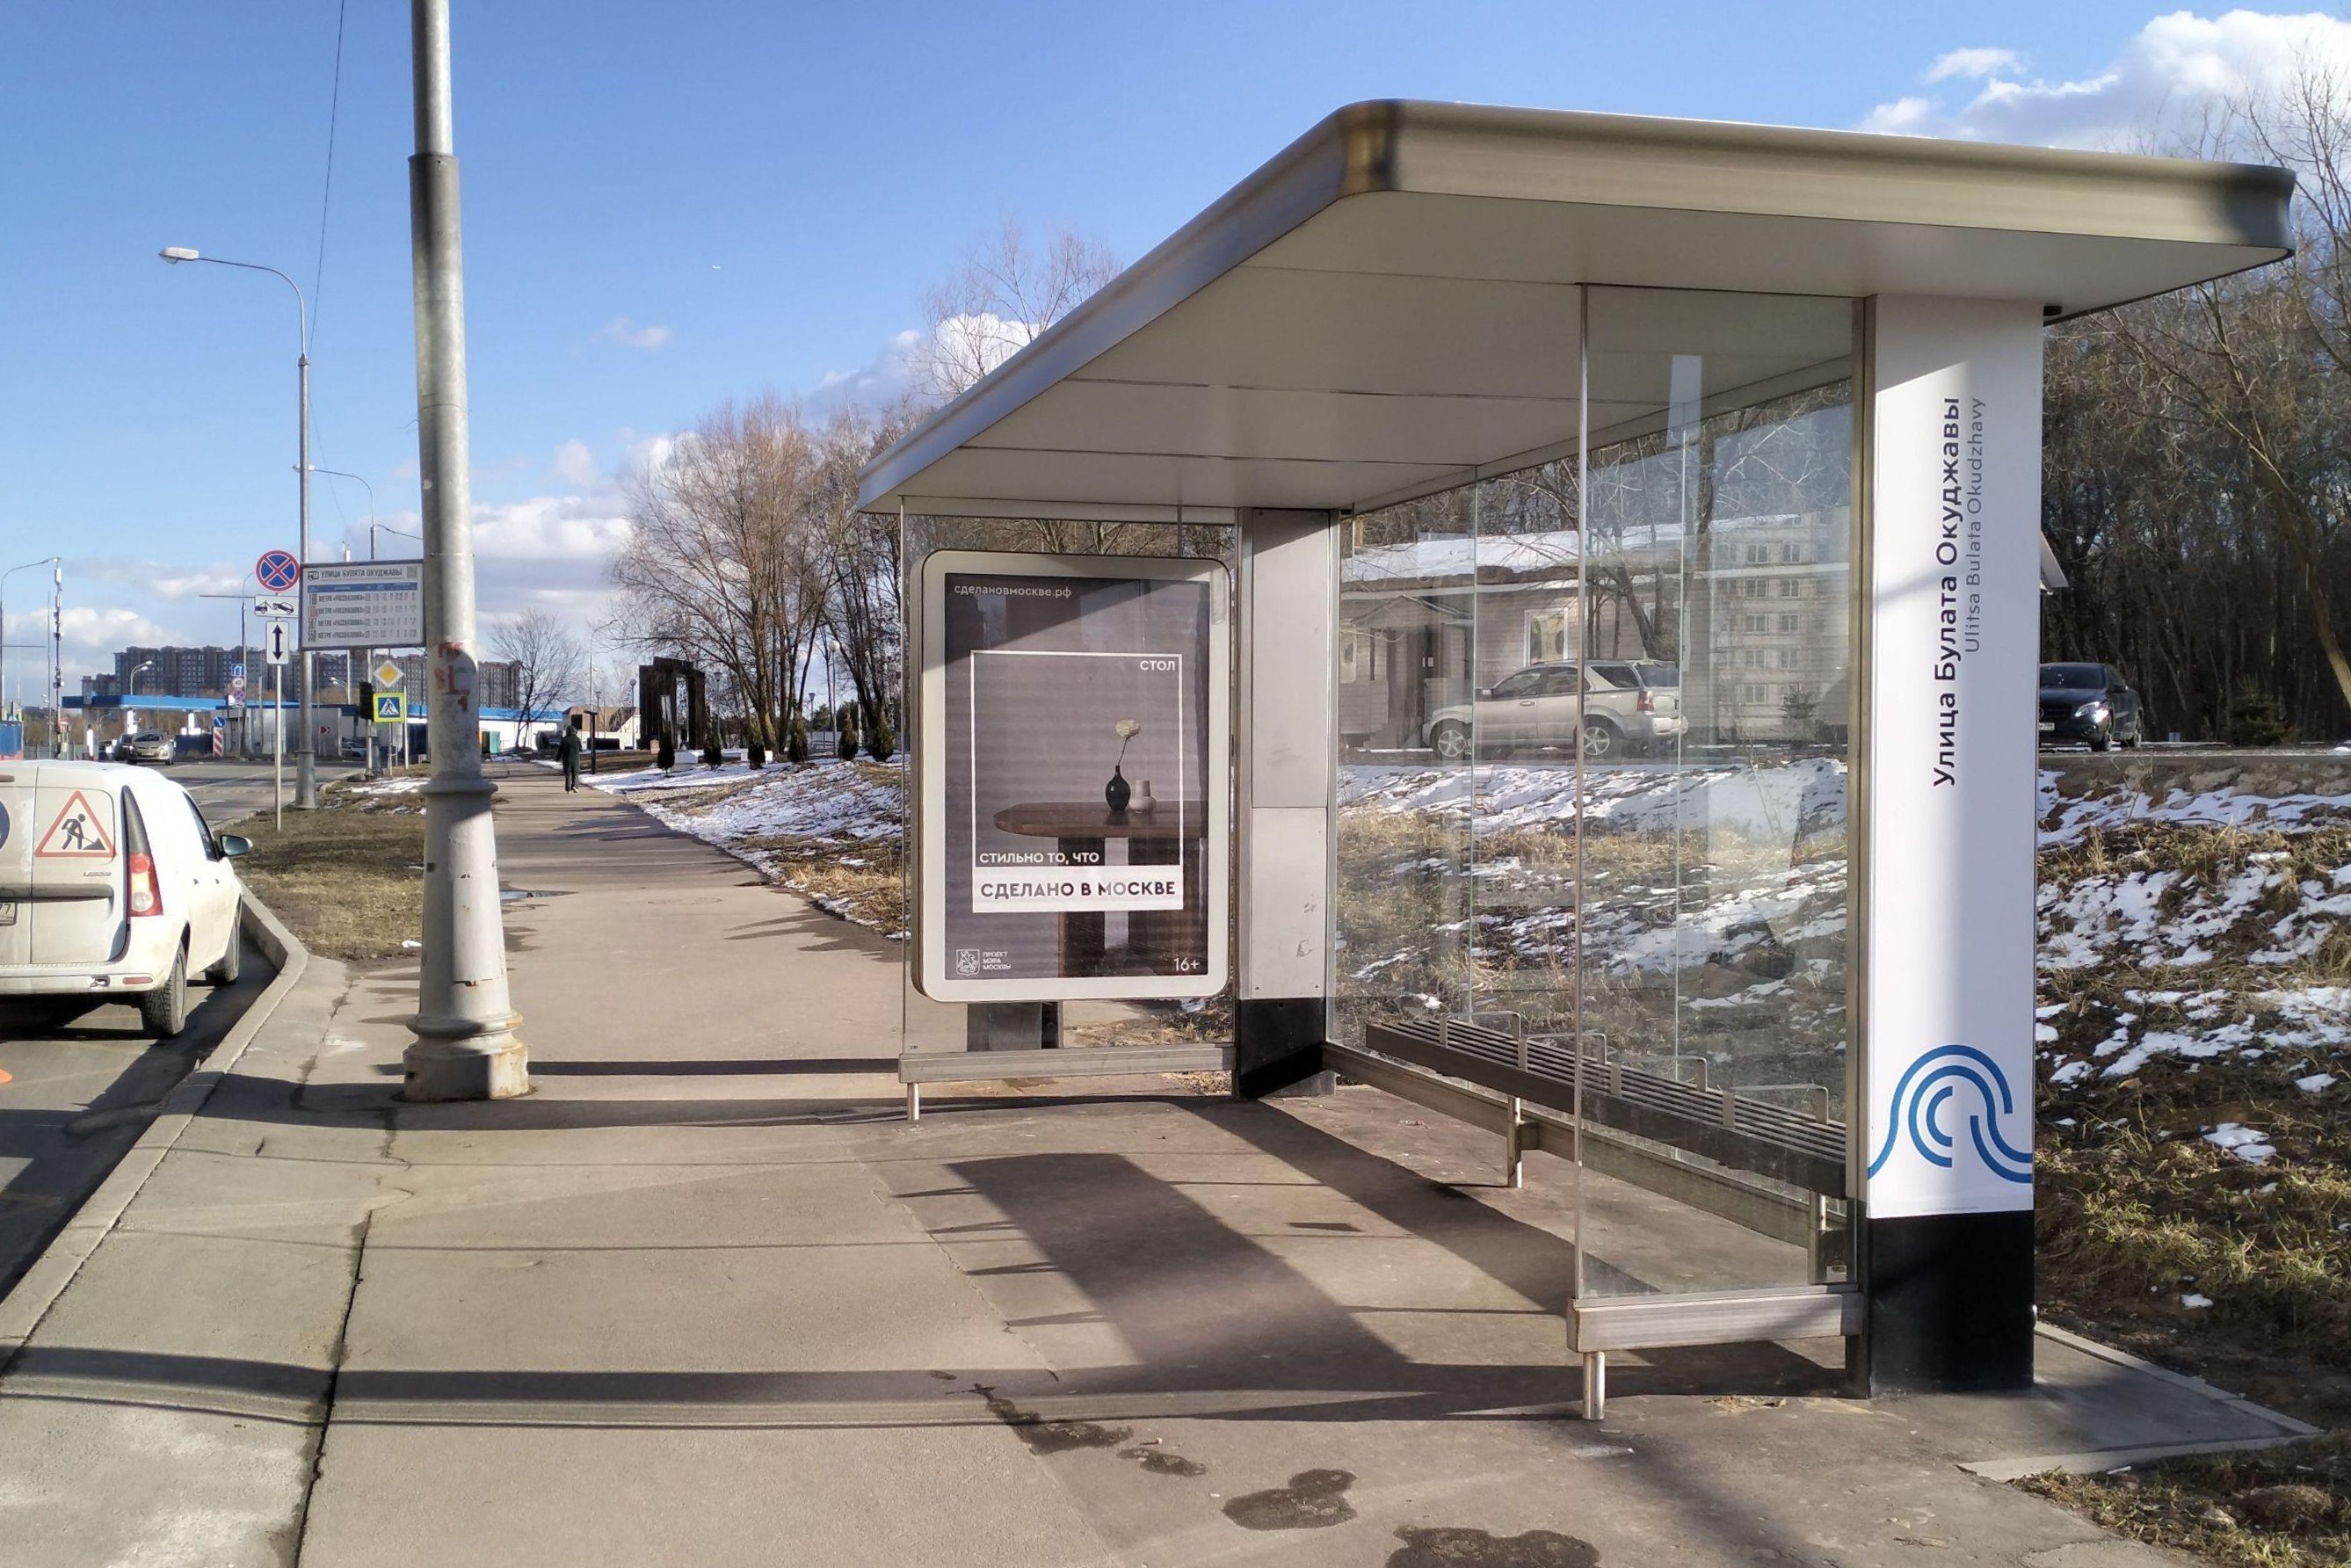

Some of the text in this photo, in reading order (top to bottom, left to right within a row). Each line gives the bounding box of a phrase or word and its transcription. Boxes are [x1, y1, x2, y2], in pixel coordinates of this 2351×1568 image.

[1964, 398, 1986, 652] Ulitsa Bulata Okudzhavy
[954, 584, 1072, 599] сделановмоскве.рф
[1934, 398, 1963, 787] Улица Булата Окуджавы
[1140, 660, 1176, 671] СТОЛ
[979, 852, 1099, 866] СТИЛЬНО ТО, ЧТО
[981, 881, 1176, 900] СДЕЛАНО В МОСКВЕ
[1173, 958, 1200, 971] 16+
